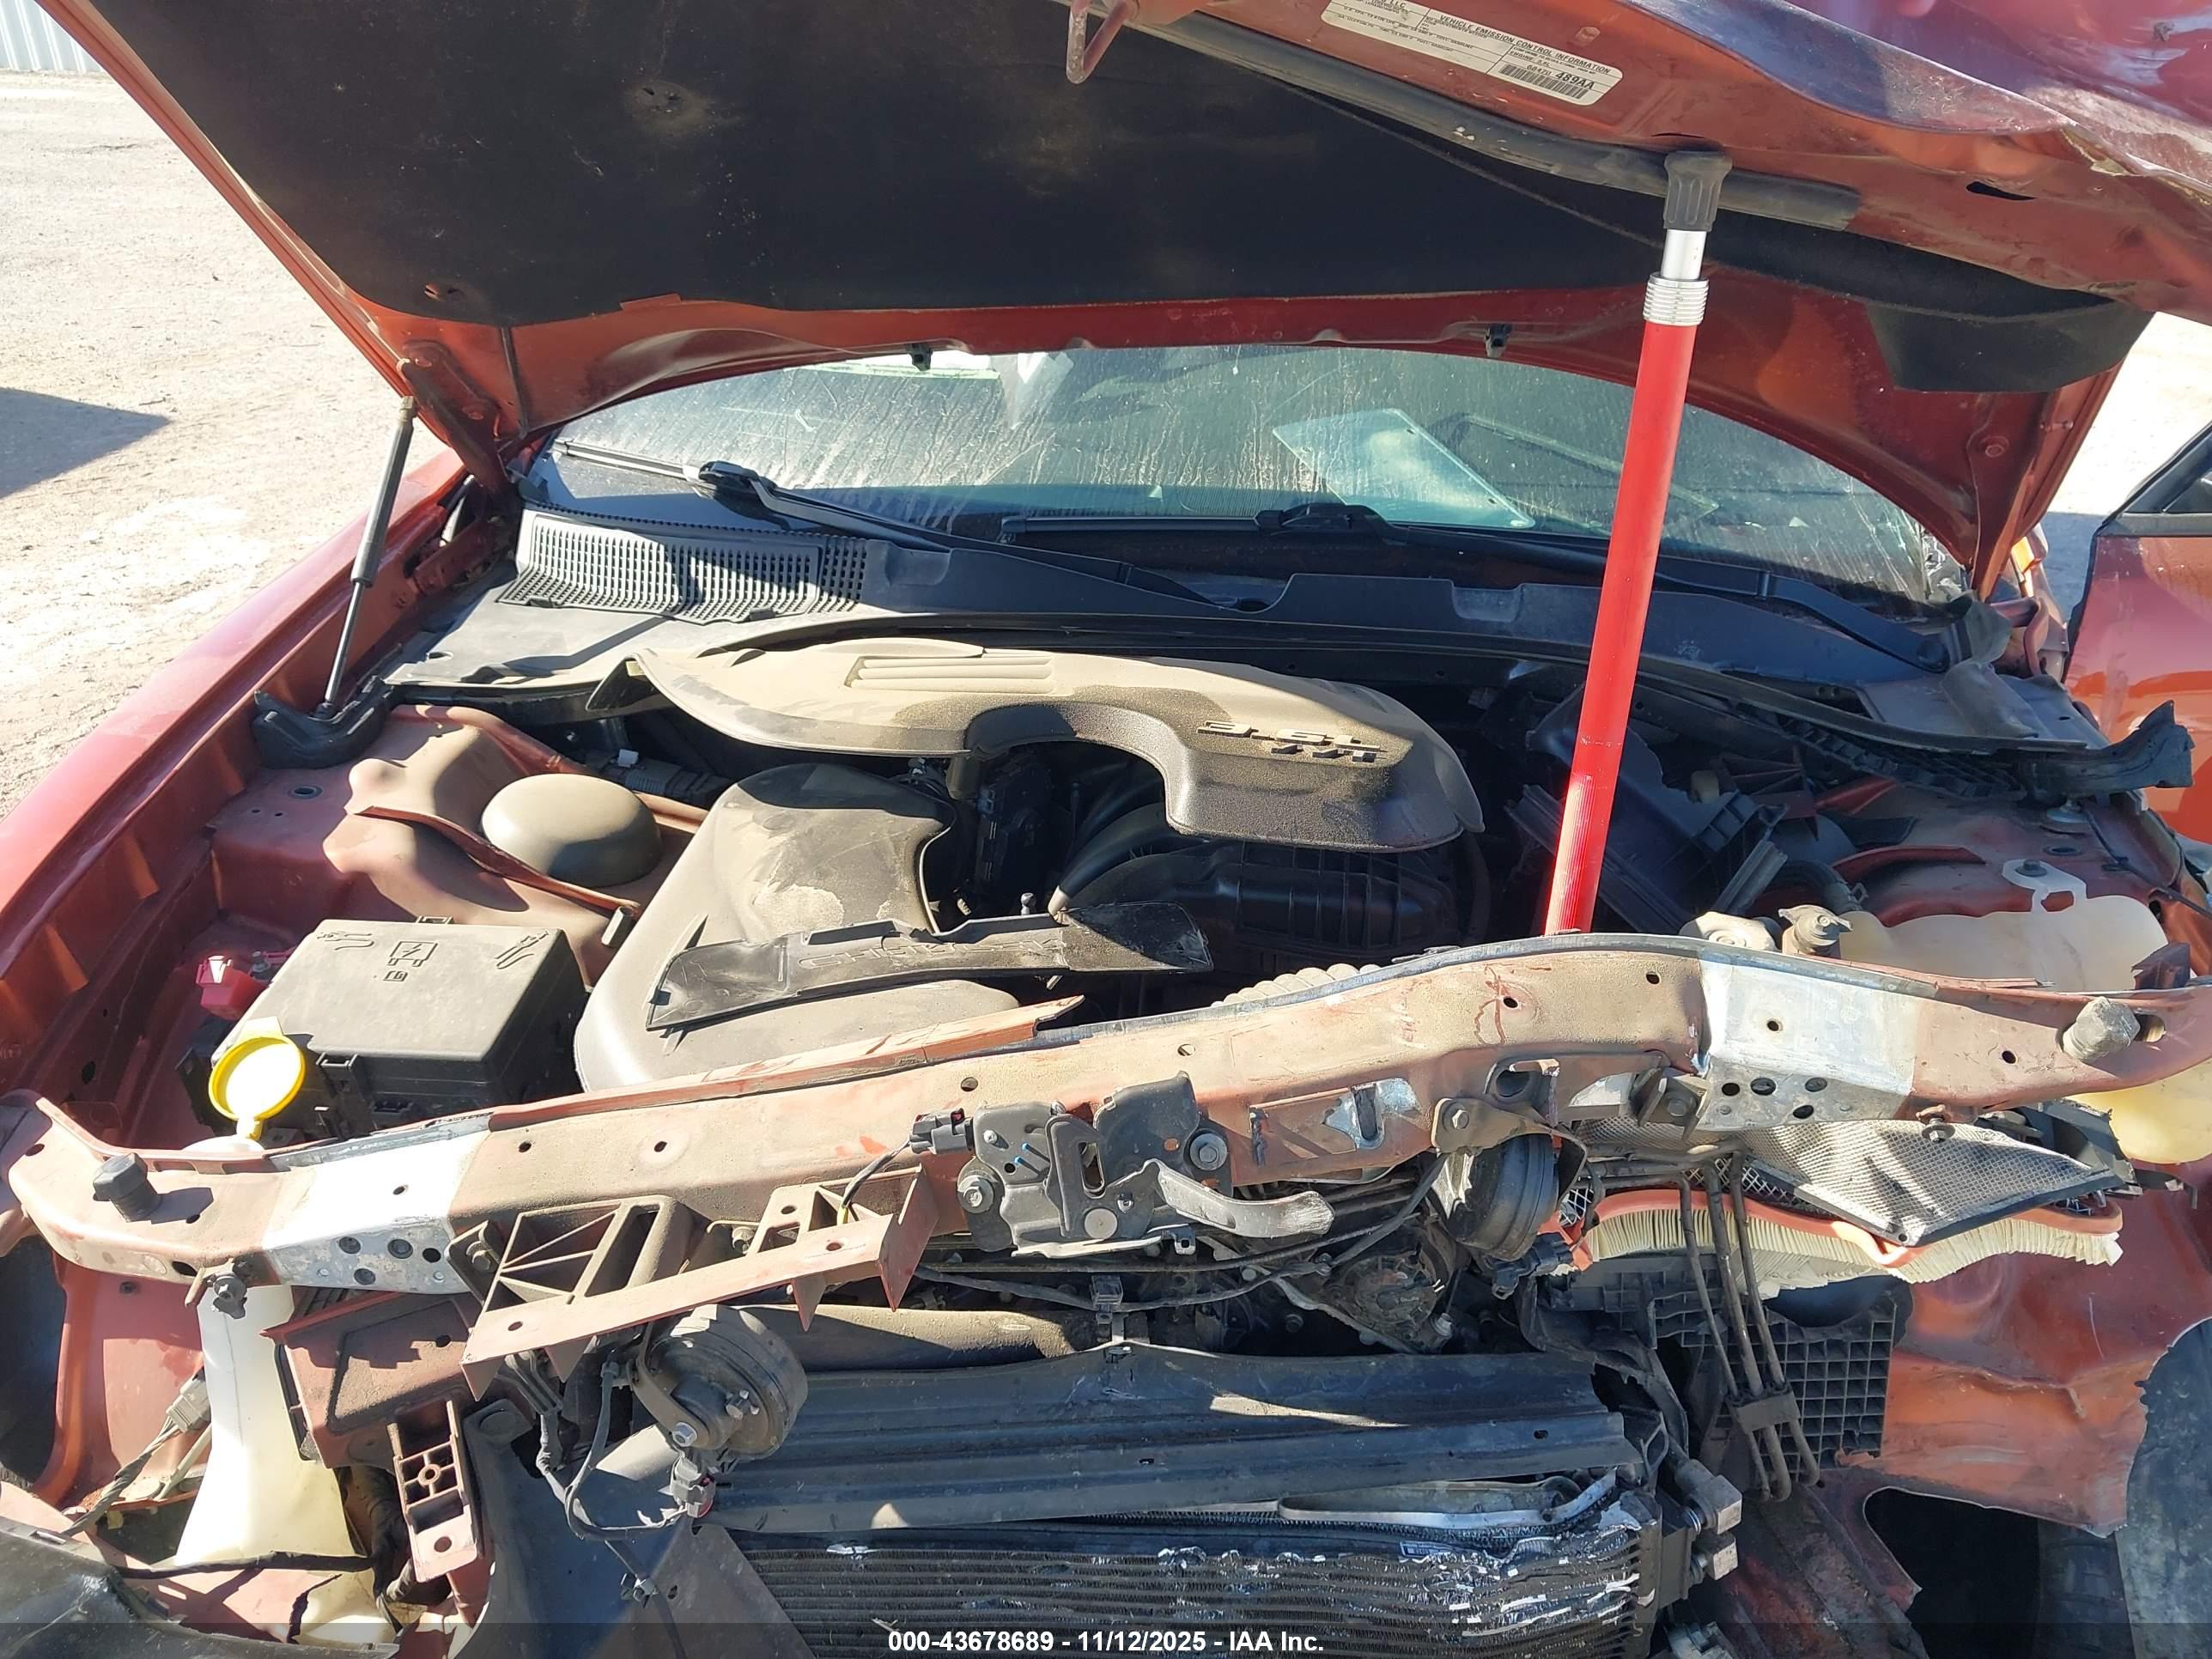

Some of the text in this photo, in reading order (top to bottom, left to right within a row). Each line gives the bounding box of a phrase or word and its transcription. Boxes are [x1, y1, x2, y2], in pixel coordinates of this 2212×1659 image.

[1439, 15, 1474, 29] VEHICLE
[1476, 27, 1515, 43] EMISSION
[1516, 40, 1553, 56] CONTROL
[1555, 52, 1611, 74] INFORMATION
[1555, 70, 1595, 90] 489AA
